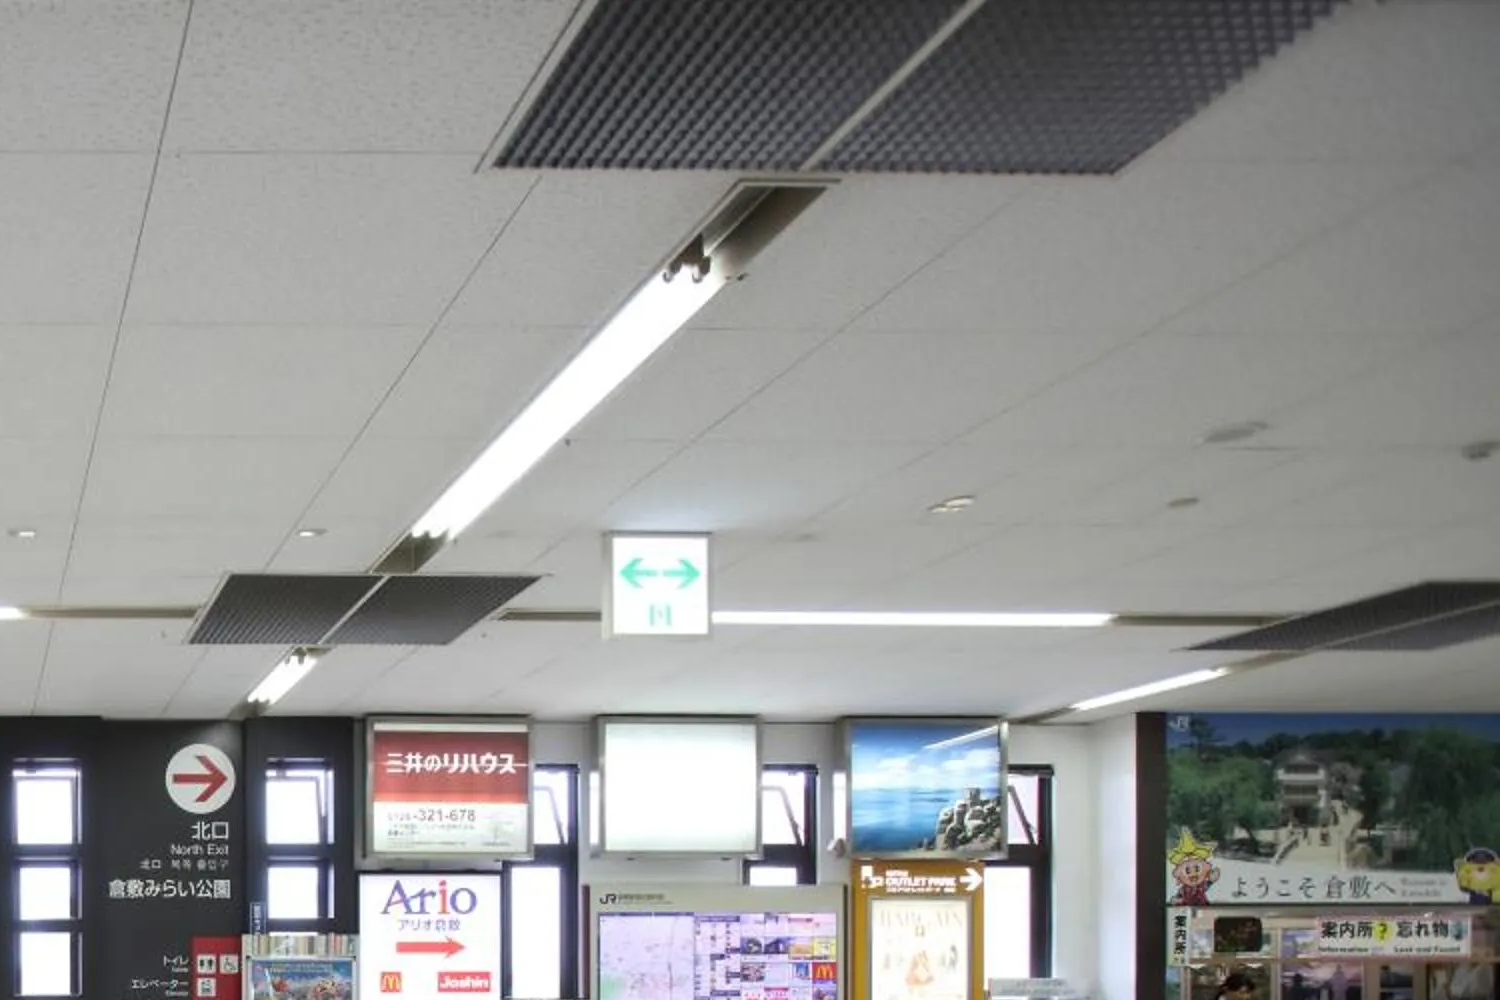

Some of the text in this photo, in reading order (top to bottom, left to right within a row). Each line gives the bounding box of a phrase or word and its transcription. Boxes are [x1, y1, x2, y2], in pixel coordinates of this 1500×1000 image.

[386, 752, 517, 774] 三井のリハウス
[191, 821, 229, 840] 北口
[170, 844, 229, 855] North Exit
[108, 879, 231, 899] 倉敷みらい公園
[380, 880, 478, 914] Ario
[600, 893, 617, 904] JR
[1322, 921, 1373, 939] 案内所
[1396, 921, 1449, 939] 忘れ物
[163, 955, 189, 966] トイレ
[440, 976, 490, 989] Joshin
